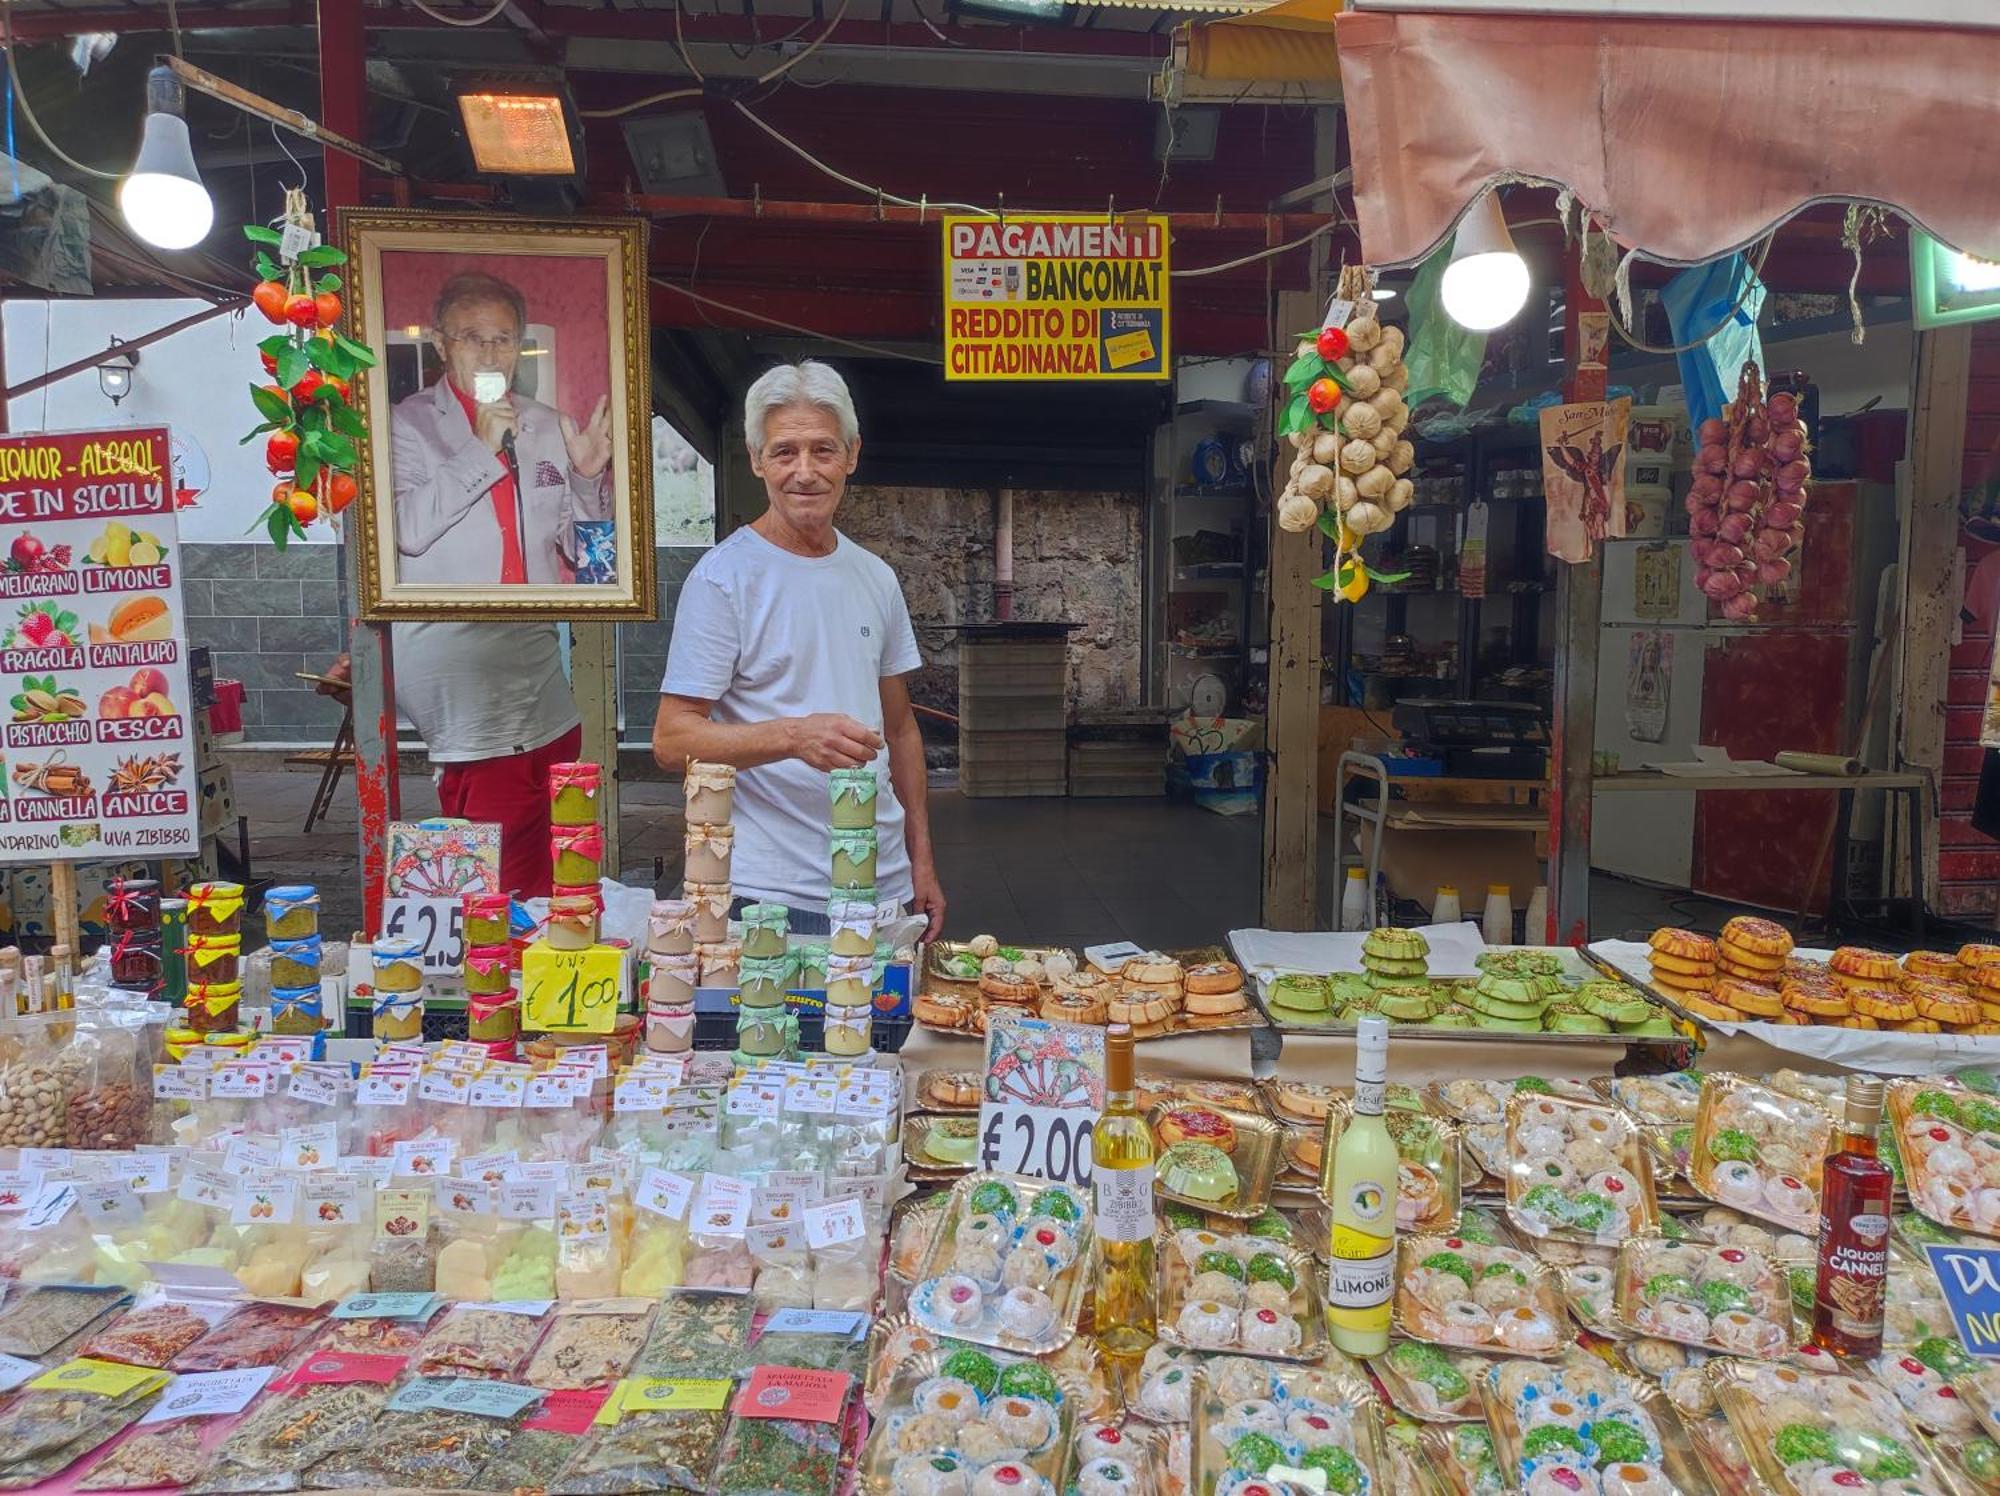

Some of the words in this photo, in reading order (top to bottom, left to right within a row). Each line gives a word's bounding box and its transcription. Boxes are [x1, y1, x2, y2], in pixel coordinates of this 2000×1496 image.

[953, 225, 1157, 257] PAGAMENTI
[1026, 261, 1163, 301] BANCOMAT
[951, 308, 1064, 338] REDDITO
[1071, 309, 1098, 338] DI
[951, 343, 1098, 374] CITTADINANZA
[80, 439, 162, 478] ALCOOL
[31, 488, 64, 515] IN
[73, 482, 163, 514] SICILY
[0, 572, 78, 596] MELOGRANO
[86, 567, 169, 590] LIMONE
[4, 647, 84, 670] FRAGOLA
[92, 641, 176, 666] CANTALUPO
[9, 718, 89, 746] PISTACCHIO
[99, 717, 182, 740] PESCA
[18, 797, 96, 820] CANNELLA
[106, 793, 186, 816] ANICE
[104, 831, 131, 847] UVA
[136, 828, 190, 846] ZIBIBBO
[1836, 1245, 1885, 1262] LIQUORE
[1335, 1272, 1390, 1294] LIMONE
